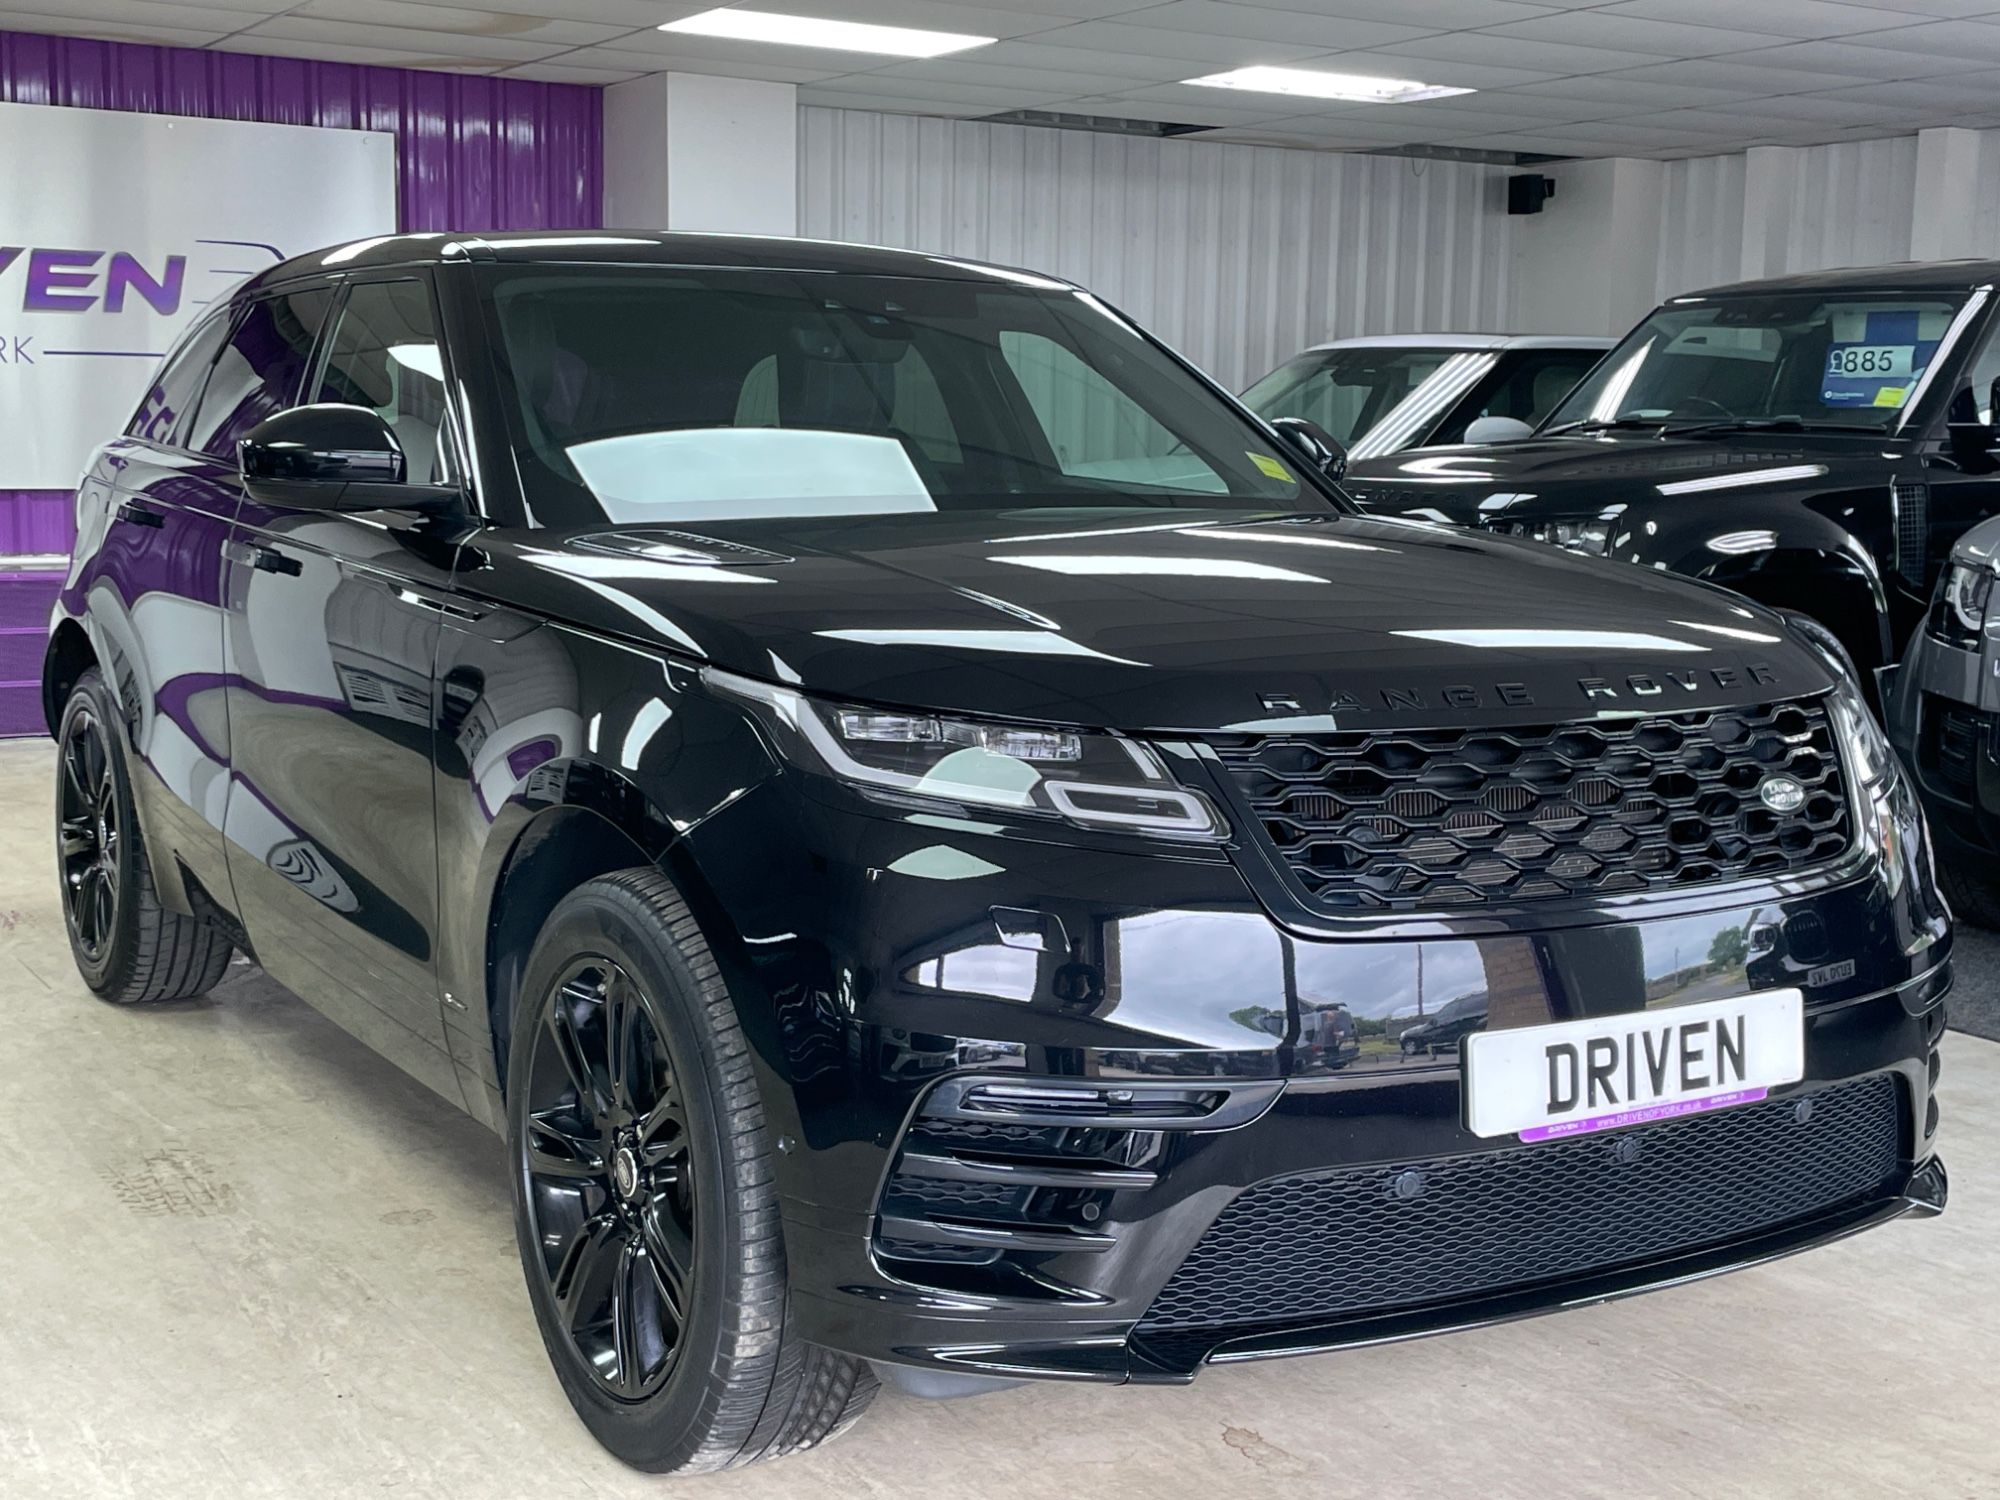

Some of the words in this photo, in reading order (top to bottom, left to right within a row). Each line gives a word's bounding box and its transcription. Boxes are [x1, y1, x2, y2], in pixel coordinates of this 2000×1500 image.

[1256, 682, 1535, 712] RANGE
[1577, 662, 1780, 702] ROVER
[1546, 1015, 1745, 1115] DRIVEN
